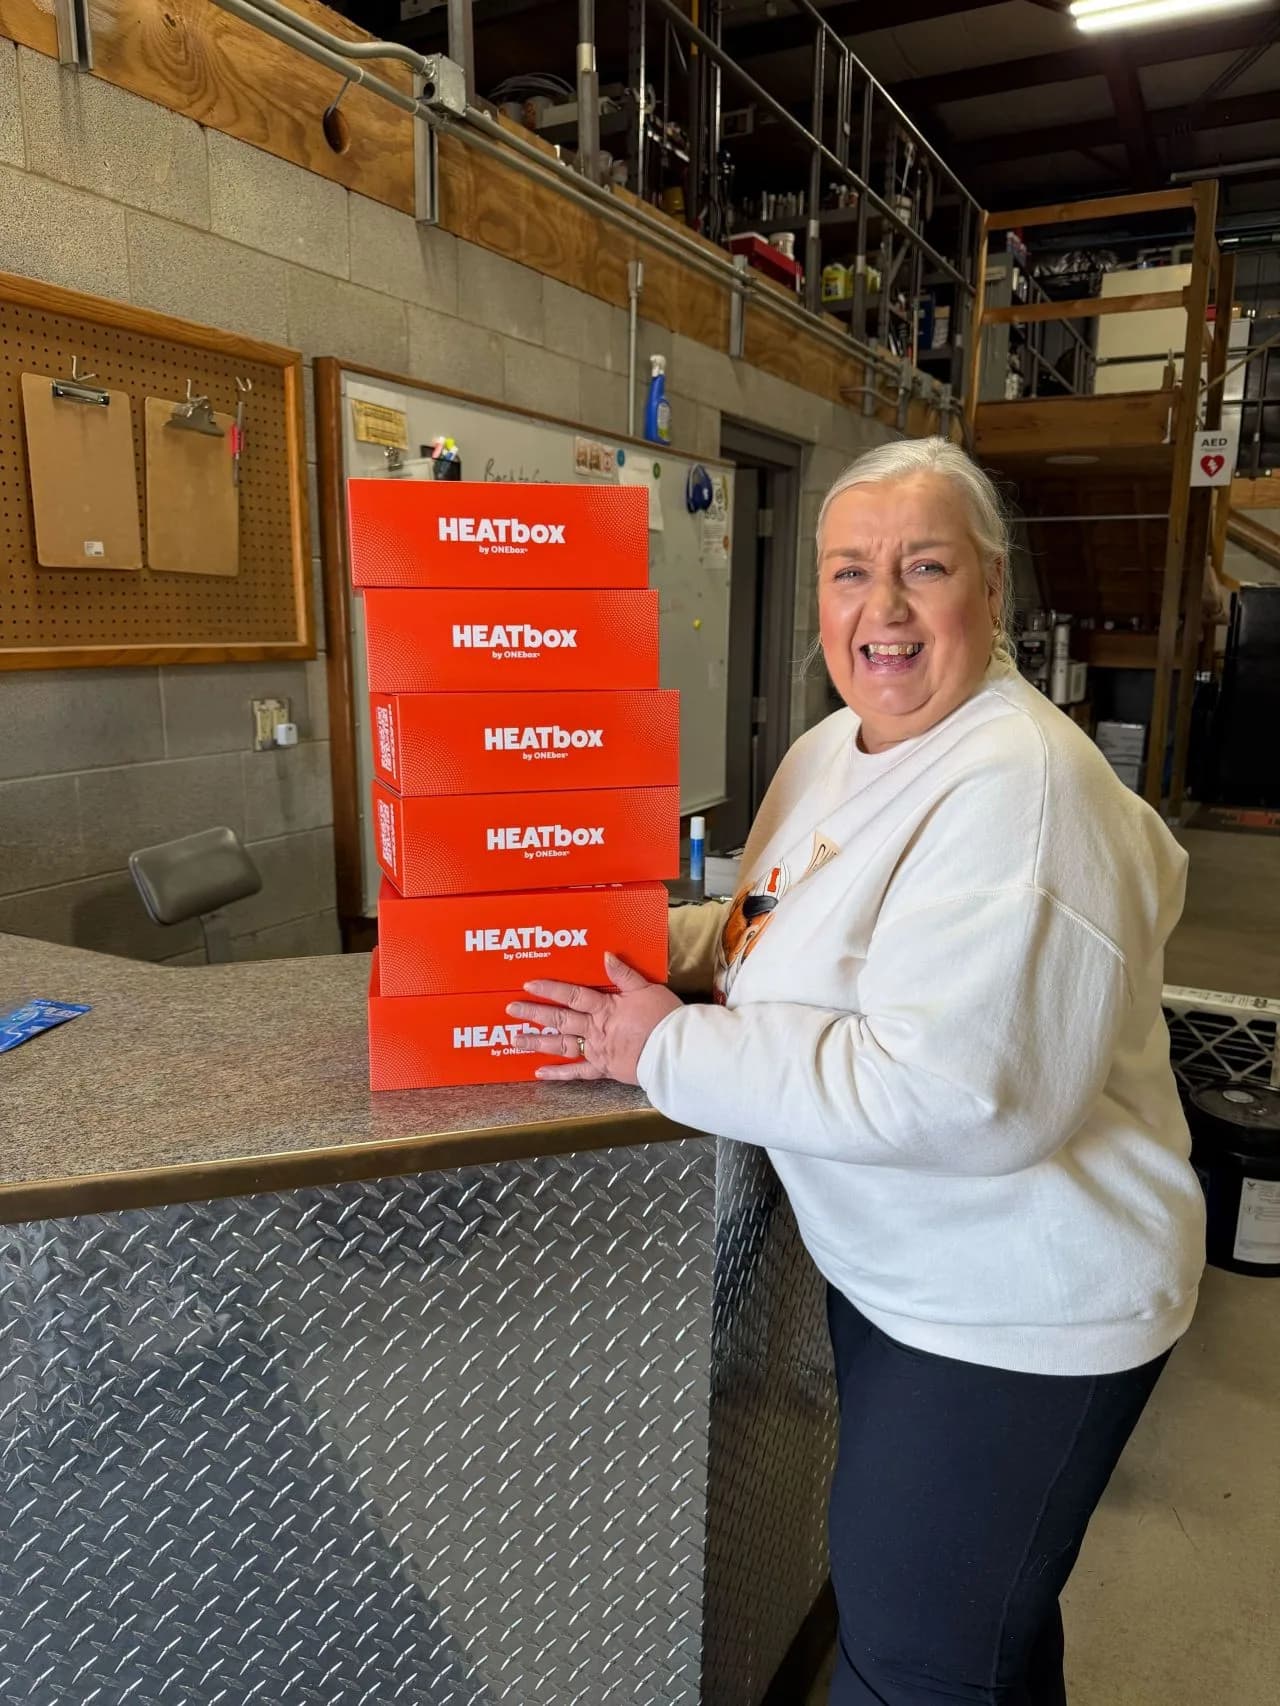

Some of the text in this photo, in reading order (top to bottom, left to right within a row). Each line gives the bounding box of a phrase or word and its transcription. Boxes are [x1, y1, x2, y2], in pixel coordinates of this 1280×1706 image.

[1201, 438, 1228, 447] AED
[438, 516, 566, 544] HEATbox
[478, 545, 490, 555] by
[451, 623, 578, 649] HEATbox
[491, 650, 503, 660] by
[484, 725, 604, 751] HEATbox
[522, 752, 533, 761] by
[486, 824, 605, 851] HEATbox
[524, 851, 535, 860] by
[464, 925, 588, 952] HEATbox
[503, 952, 514, 961] by
[453, 1022, 559, 1049] HEAT
[490, 1048, 502, 1057] by
